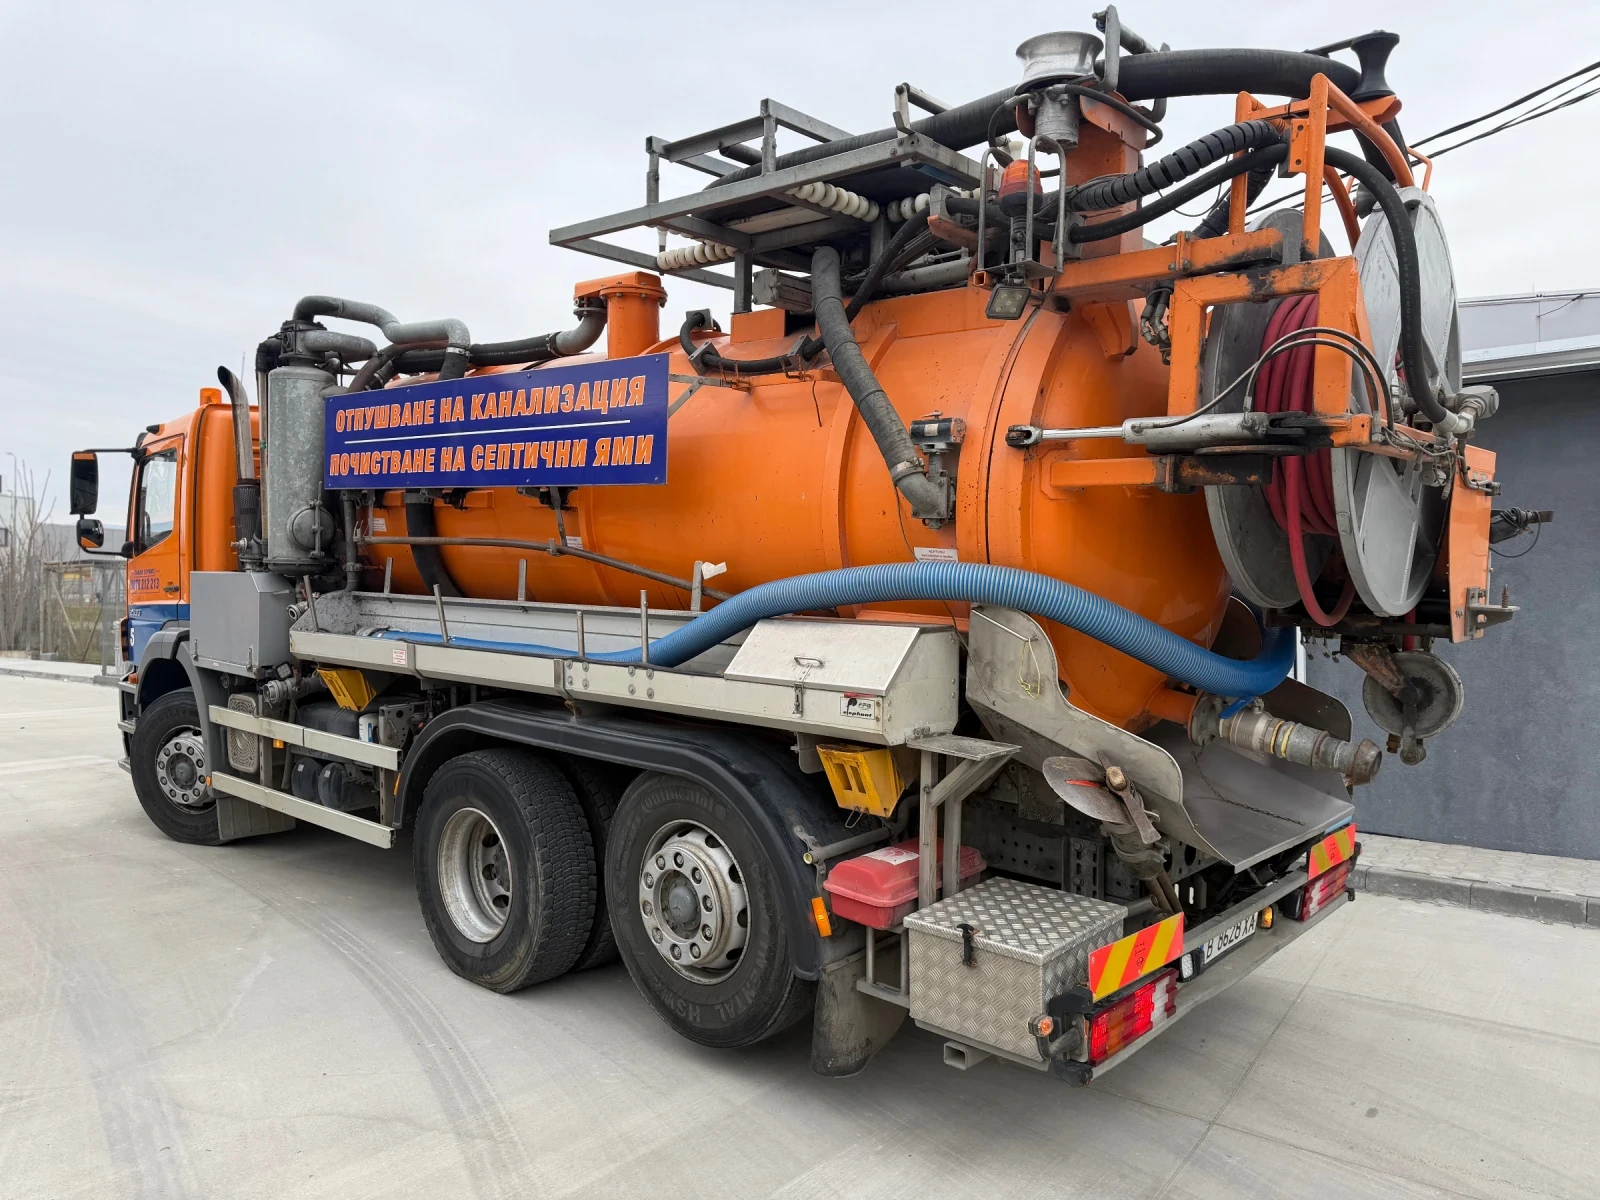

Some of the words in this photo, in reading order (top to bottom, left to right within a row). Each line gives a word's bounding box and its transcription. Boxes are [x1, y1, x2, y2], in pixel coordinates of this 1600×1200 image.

[335, 399, 435, 433] ОТПУШВАНЕ
[440, 395, 465, 423] НА
[470, 375, 646, 421] КАНАЛИЗАЦИЯ
[329, 447, 435, 477] ПОЧИСТВАНЕ
[440, 446, 466, 472] НА
[470, 438, 588, 471] СЕПТИЧНИ
[593, 435, 654, 467] ЯМИ
[640, 786, 715, 814] Continental
